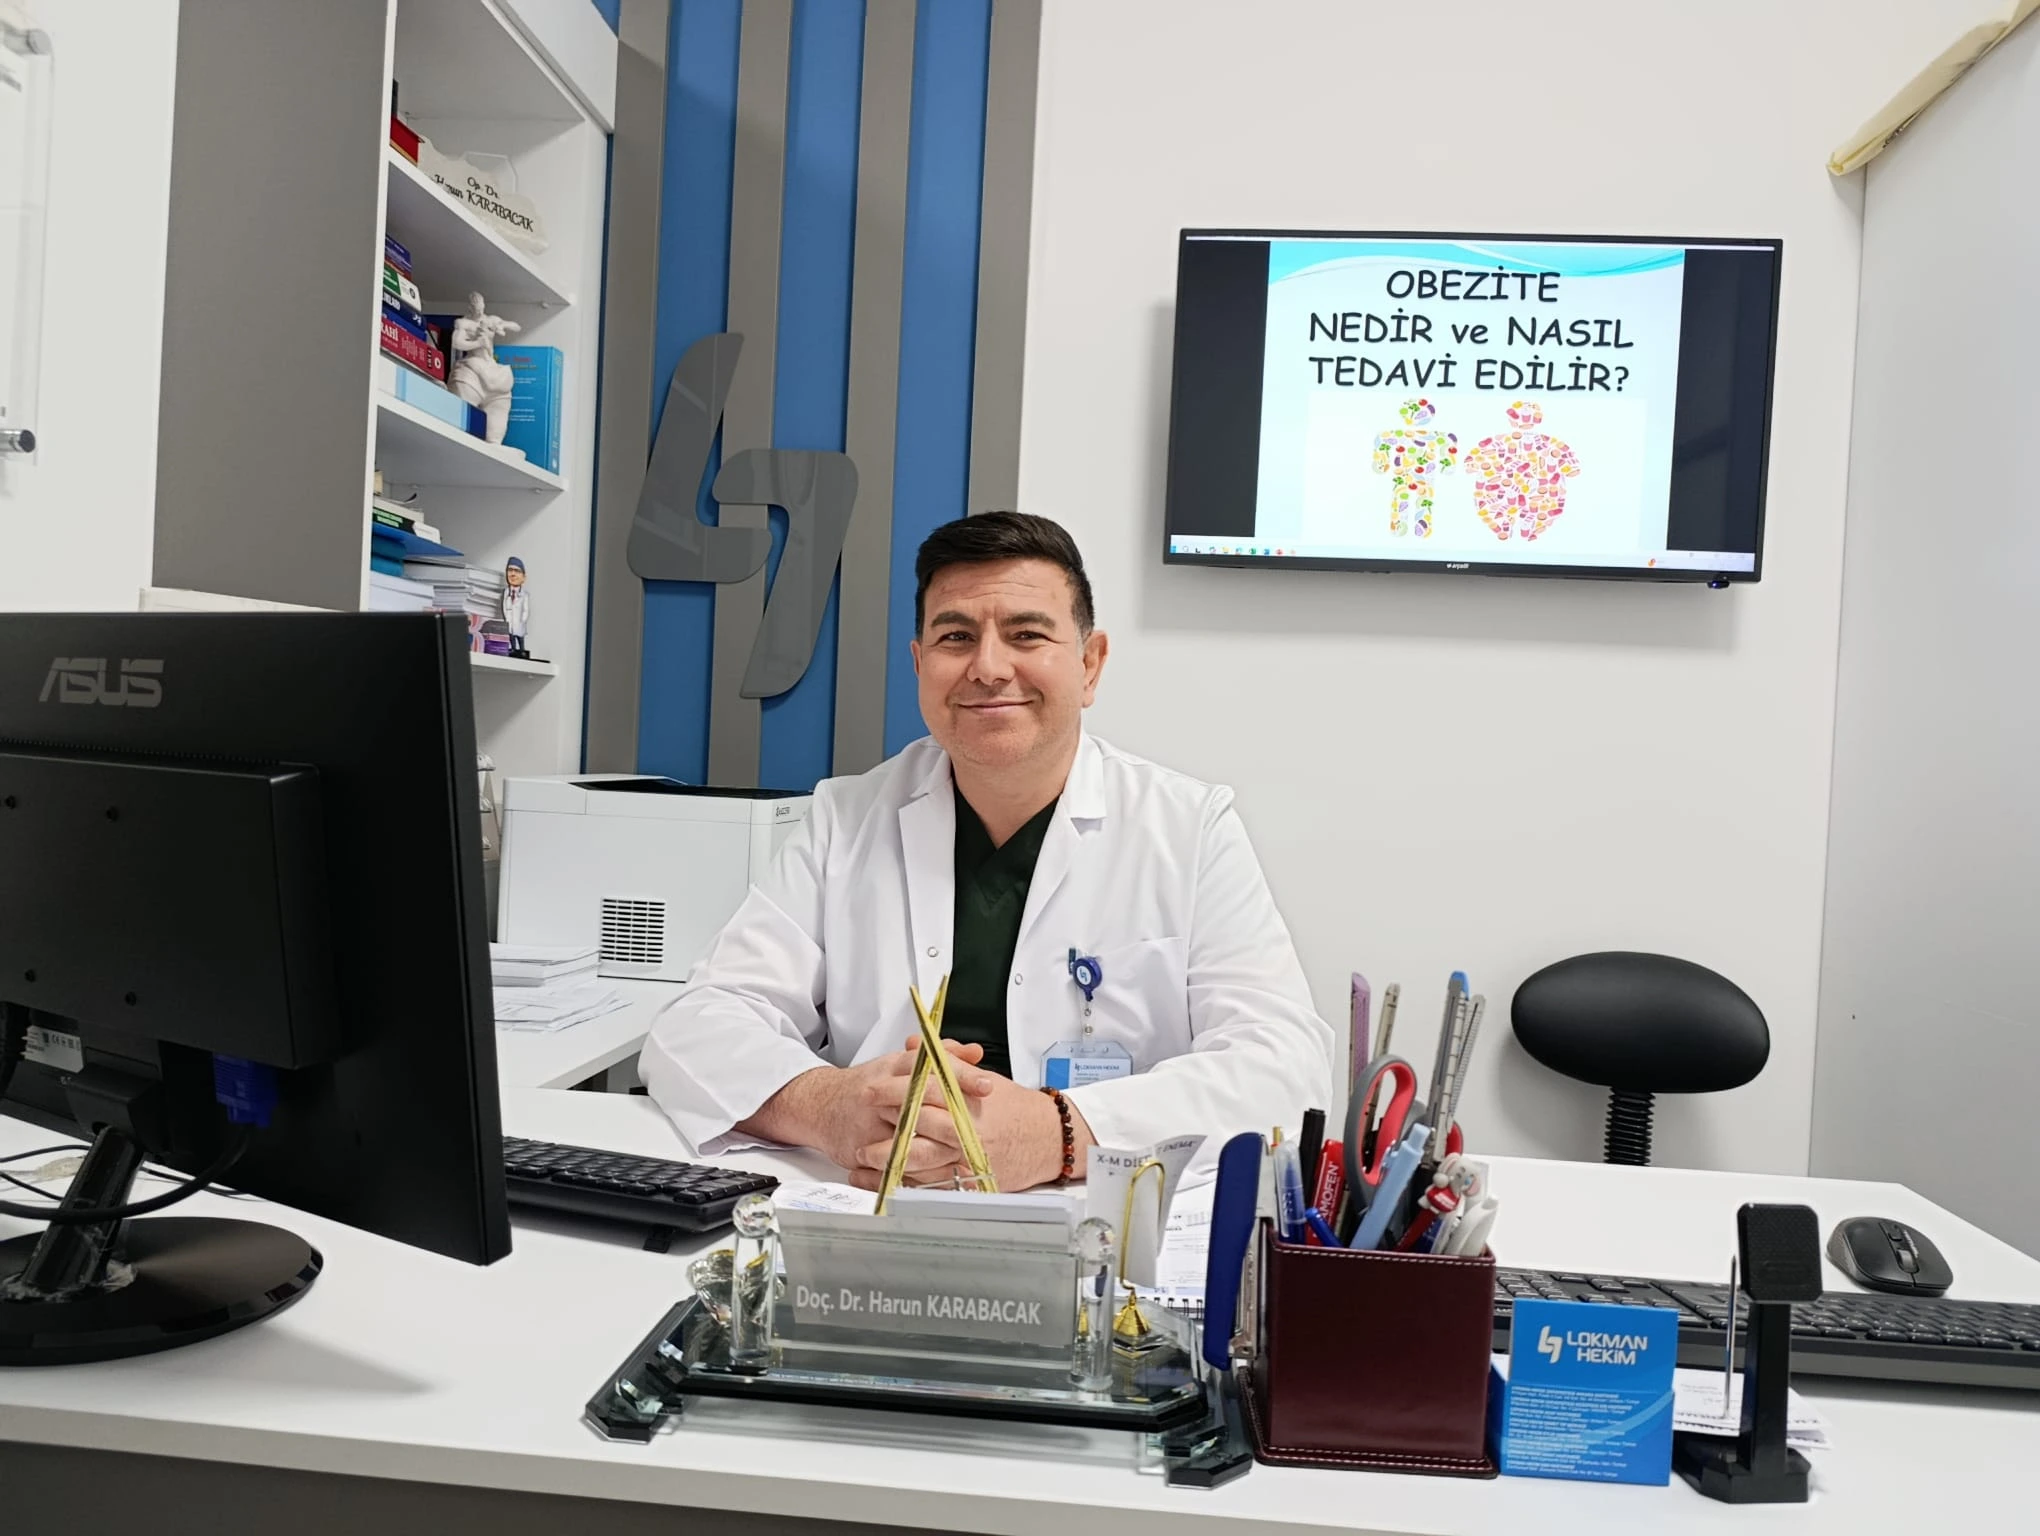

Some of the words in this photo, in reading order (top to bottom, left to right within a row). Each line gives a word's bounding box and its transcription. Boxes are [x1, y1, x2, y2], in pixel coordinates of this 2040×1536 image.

[466, 189, 533, 232] KARABACAK
[1386, 265, 1561, 302] OBEZİTE
[1309, 307, 1433, 343] NEDİR
[1451, 323, 1489, 344] ve
[1507, 316, 1634, 348] NASIL
[1308, 352, 1458, 388] TEDAVİ
[1475, 355, 1630, 392] EDİLİR?
[39, 657, 164, 707] ASUS
[1097, 1154, 1120, 1166] X-M
[796, 1285, 835, 1315] Doç.
[839, 1288, 864, 1312] Dr.
[869, 1290, 922, 1316] Harun
[926, 1294, 1042, 1325] KARABACAK
[1566, 1330, 1648, 1351] LOKMAN
